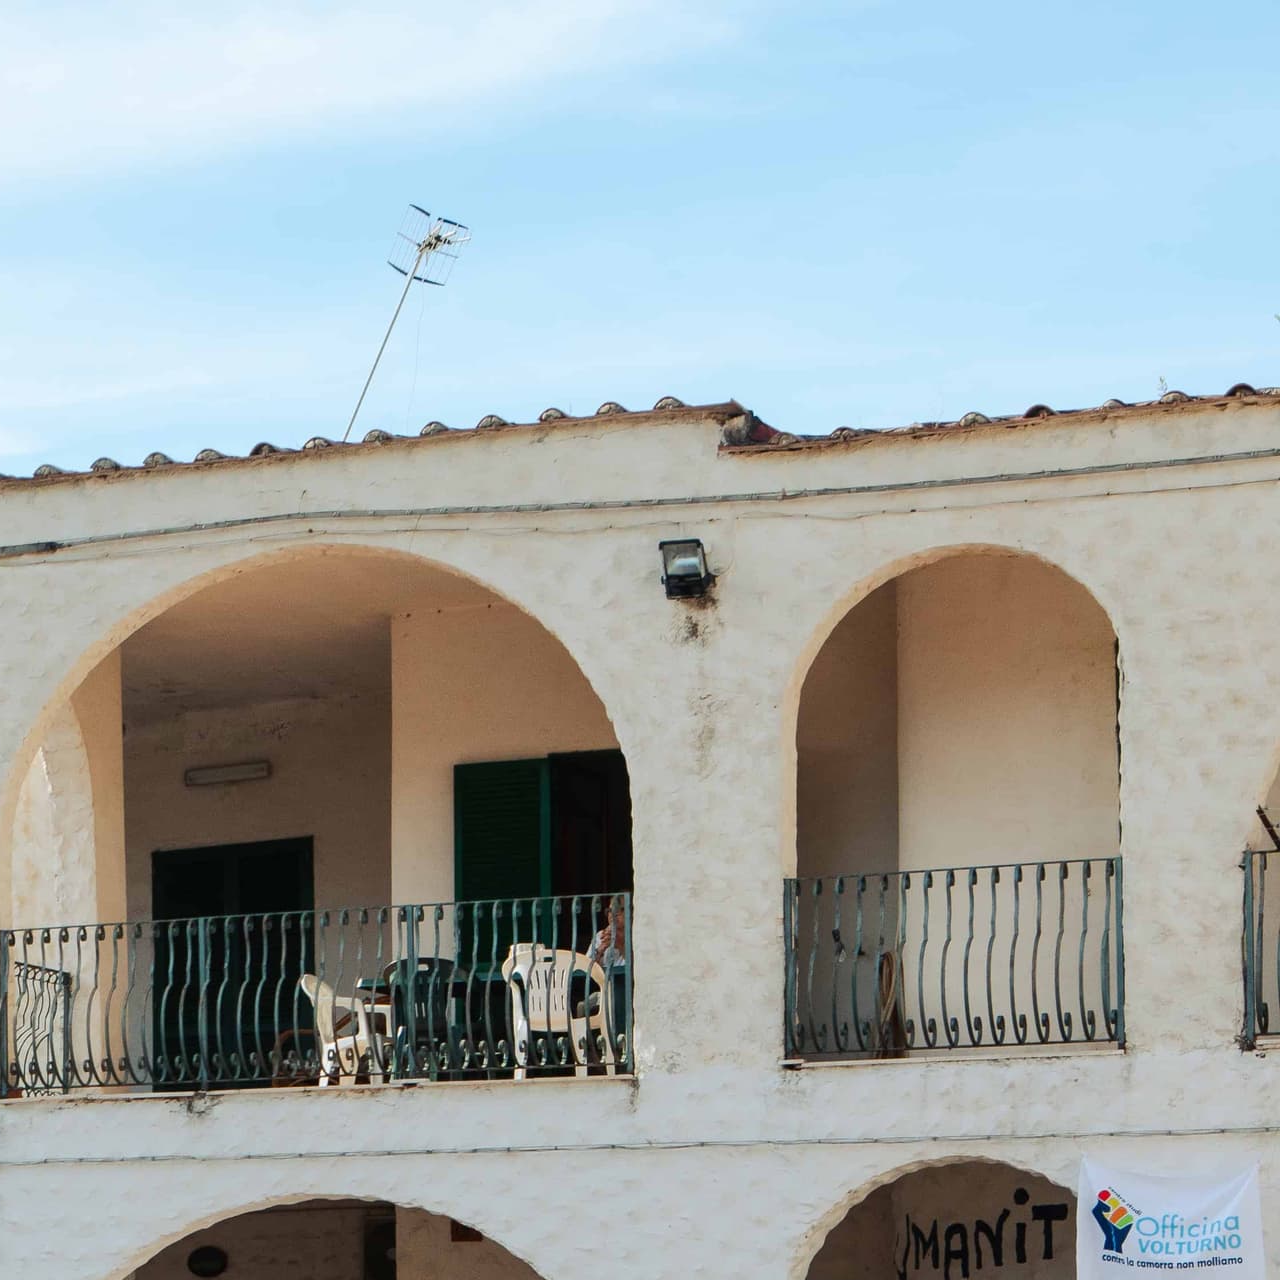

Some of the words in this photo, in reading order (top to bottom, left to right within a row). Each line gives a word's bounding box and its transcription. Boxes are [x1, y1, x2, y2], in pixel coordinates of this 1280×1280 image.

[1136, 1214, 1240, 1239] Officina
[1138, 1234, 1242, 1255] VOLTURNO
[1126, 1256, 1134, 1267] la
[1137, 1260, 1174, 1269] camorra
[1176, 1261, 1195, 1269] non
[1197, 1256, 1243, 1268] molliamo
